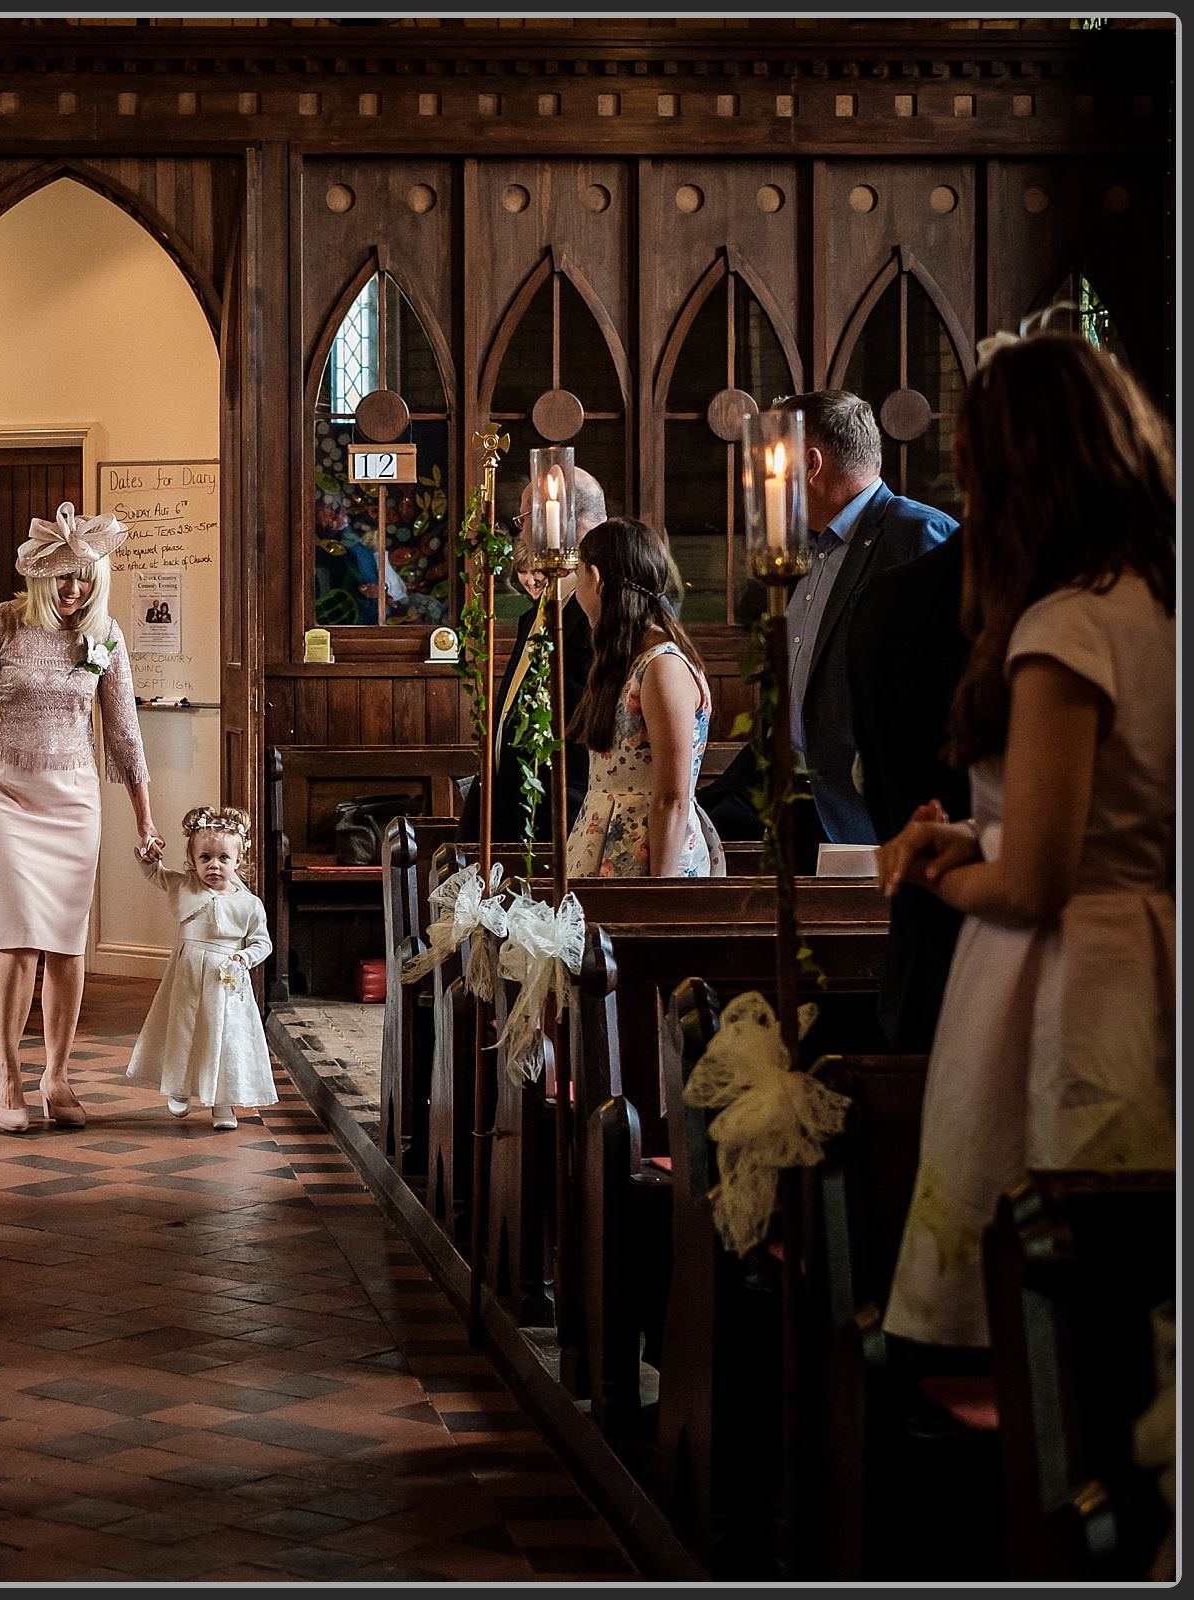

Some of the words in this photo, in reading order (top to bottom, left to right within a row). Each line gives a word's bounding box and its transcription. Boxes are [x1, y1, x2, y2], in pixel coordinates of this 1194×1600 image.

[360, 453, 395, 478] 12
[110, 468, 143, 491] Dates
[153, 468, 173, 490] for
[182, 467, 216, 495] Diary
